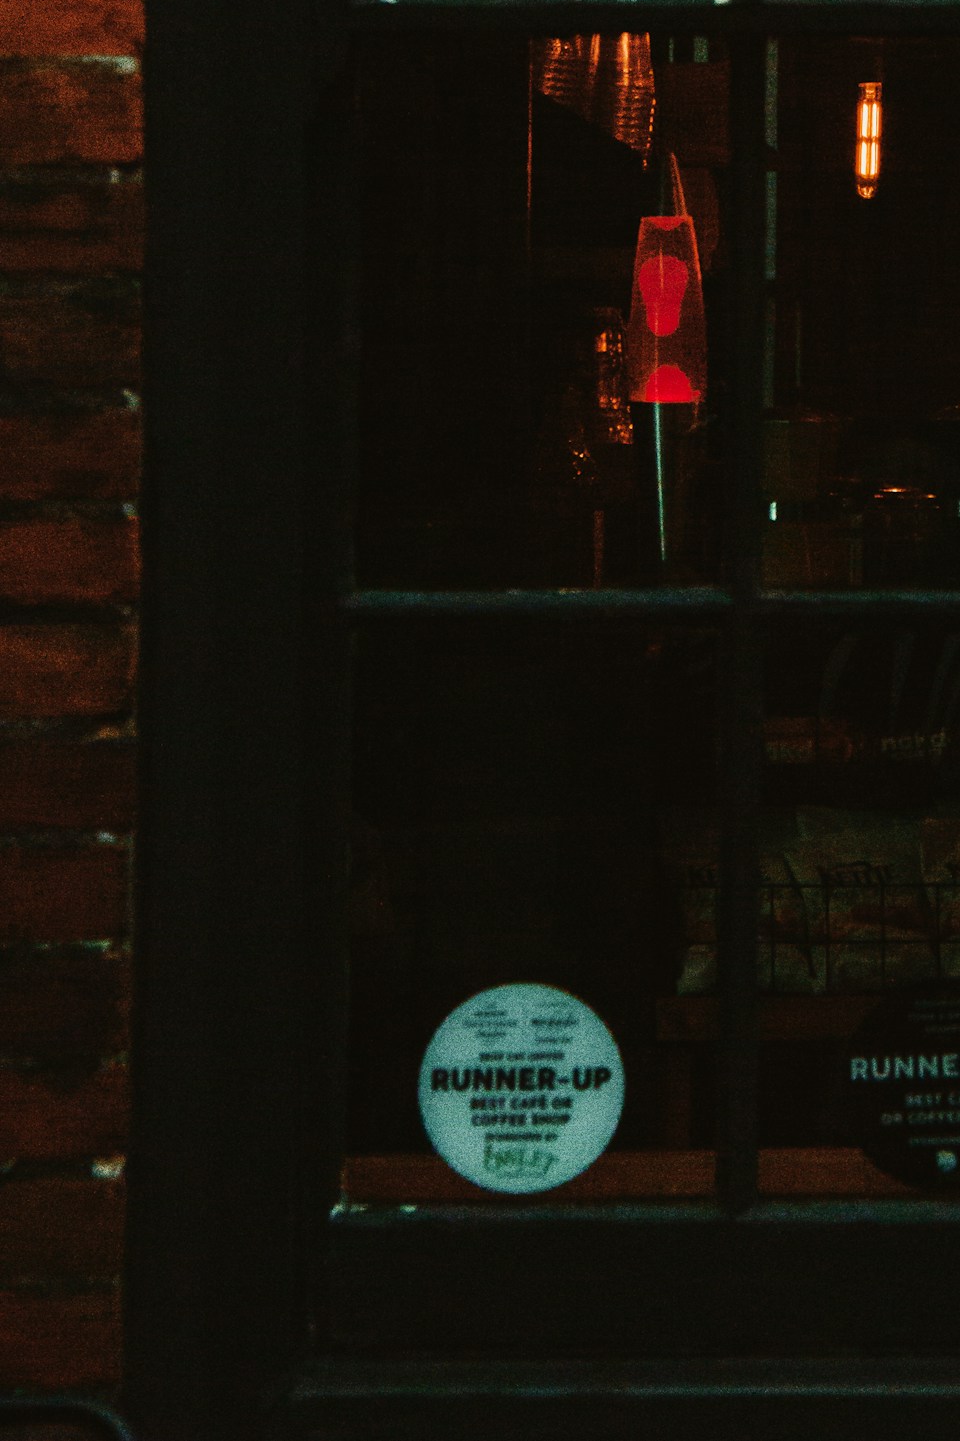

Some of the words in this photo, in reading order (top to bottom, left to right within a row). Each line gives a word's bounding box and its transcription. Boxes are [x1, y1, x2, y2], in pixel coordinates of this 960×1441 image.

[431, 1067, 611, 1092] RUNNER-UP
[470, 1097, 507, 1110] BEST
[904, 1092, 942, 1108] BEST
[472, 1113, 528, 1126] COFFEE
